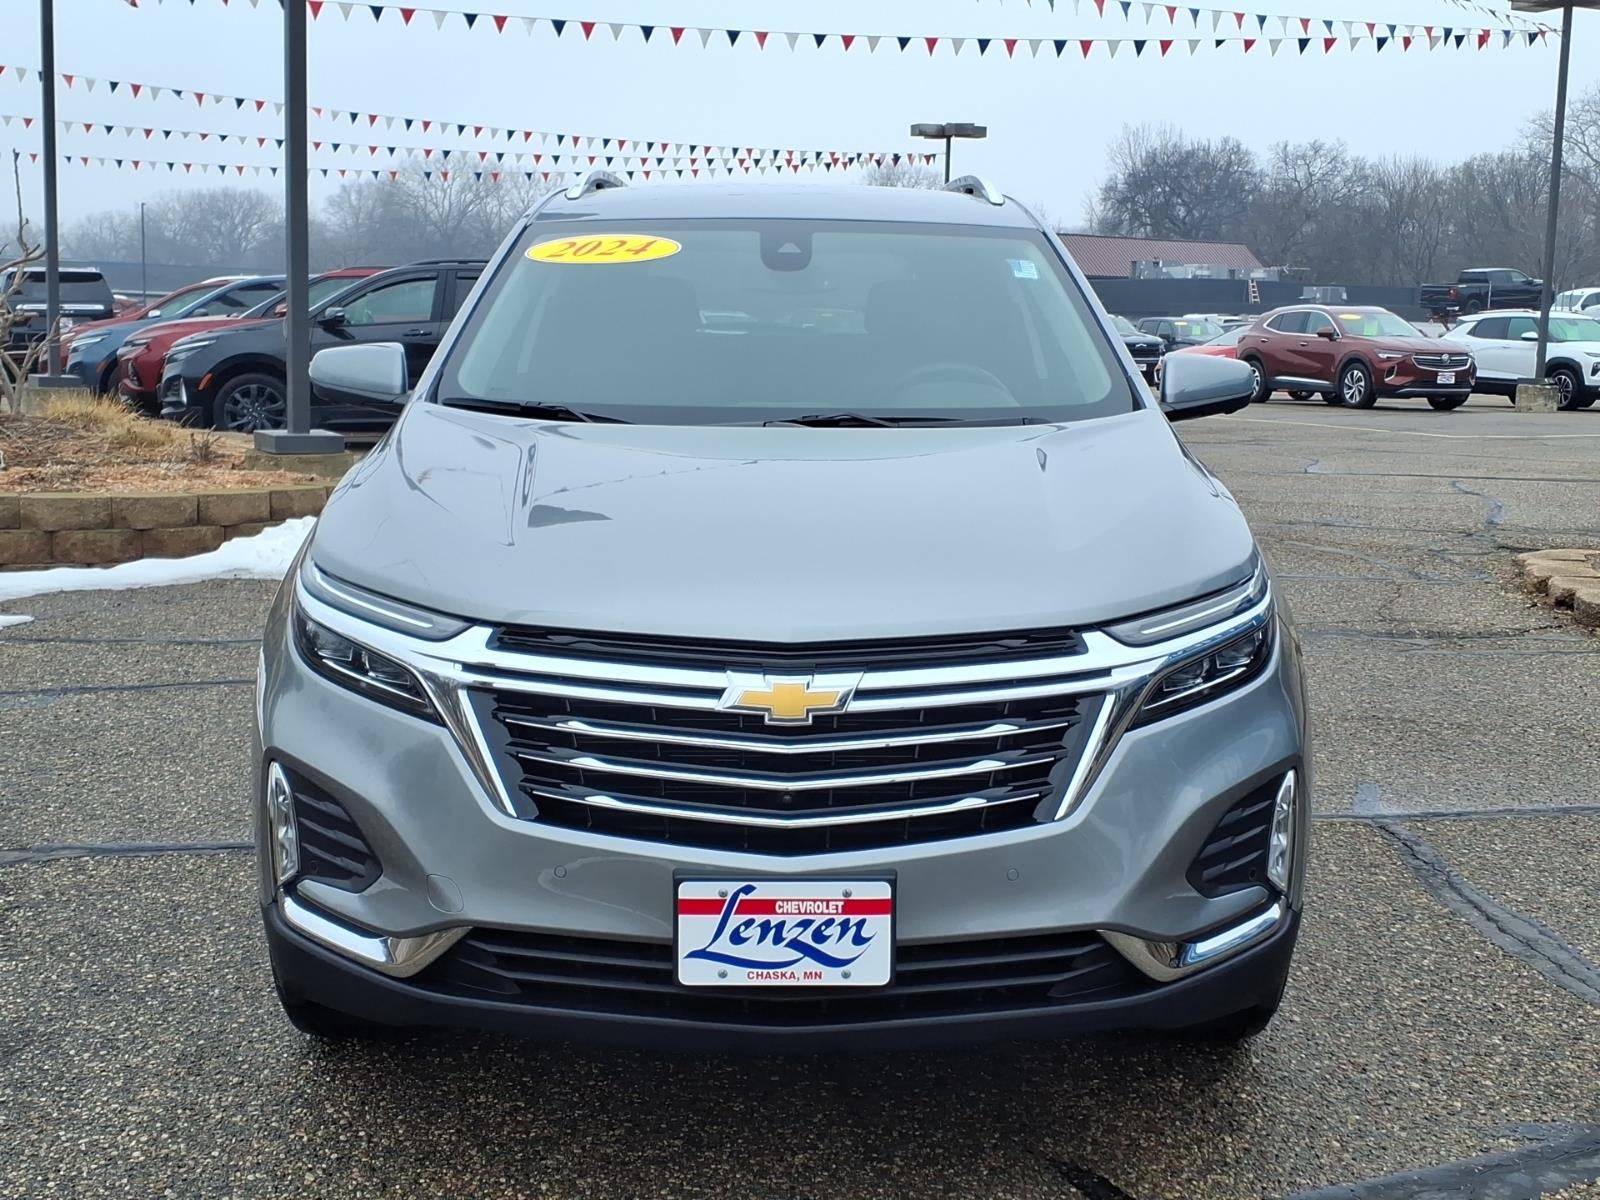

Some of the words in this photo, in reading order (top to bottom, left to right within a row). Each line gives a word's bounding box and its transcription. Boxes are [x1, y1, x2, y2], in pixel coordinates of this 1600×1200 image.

[546, 239, 658, 258] 2024
[775, 901, 844, 914] CHEVROLET
[683, 884, 877, 969] Lenzen
[747, 971, 800, 981] CHASKA,
[803, 971, 822, 980] MN
